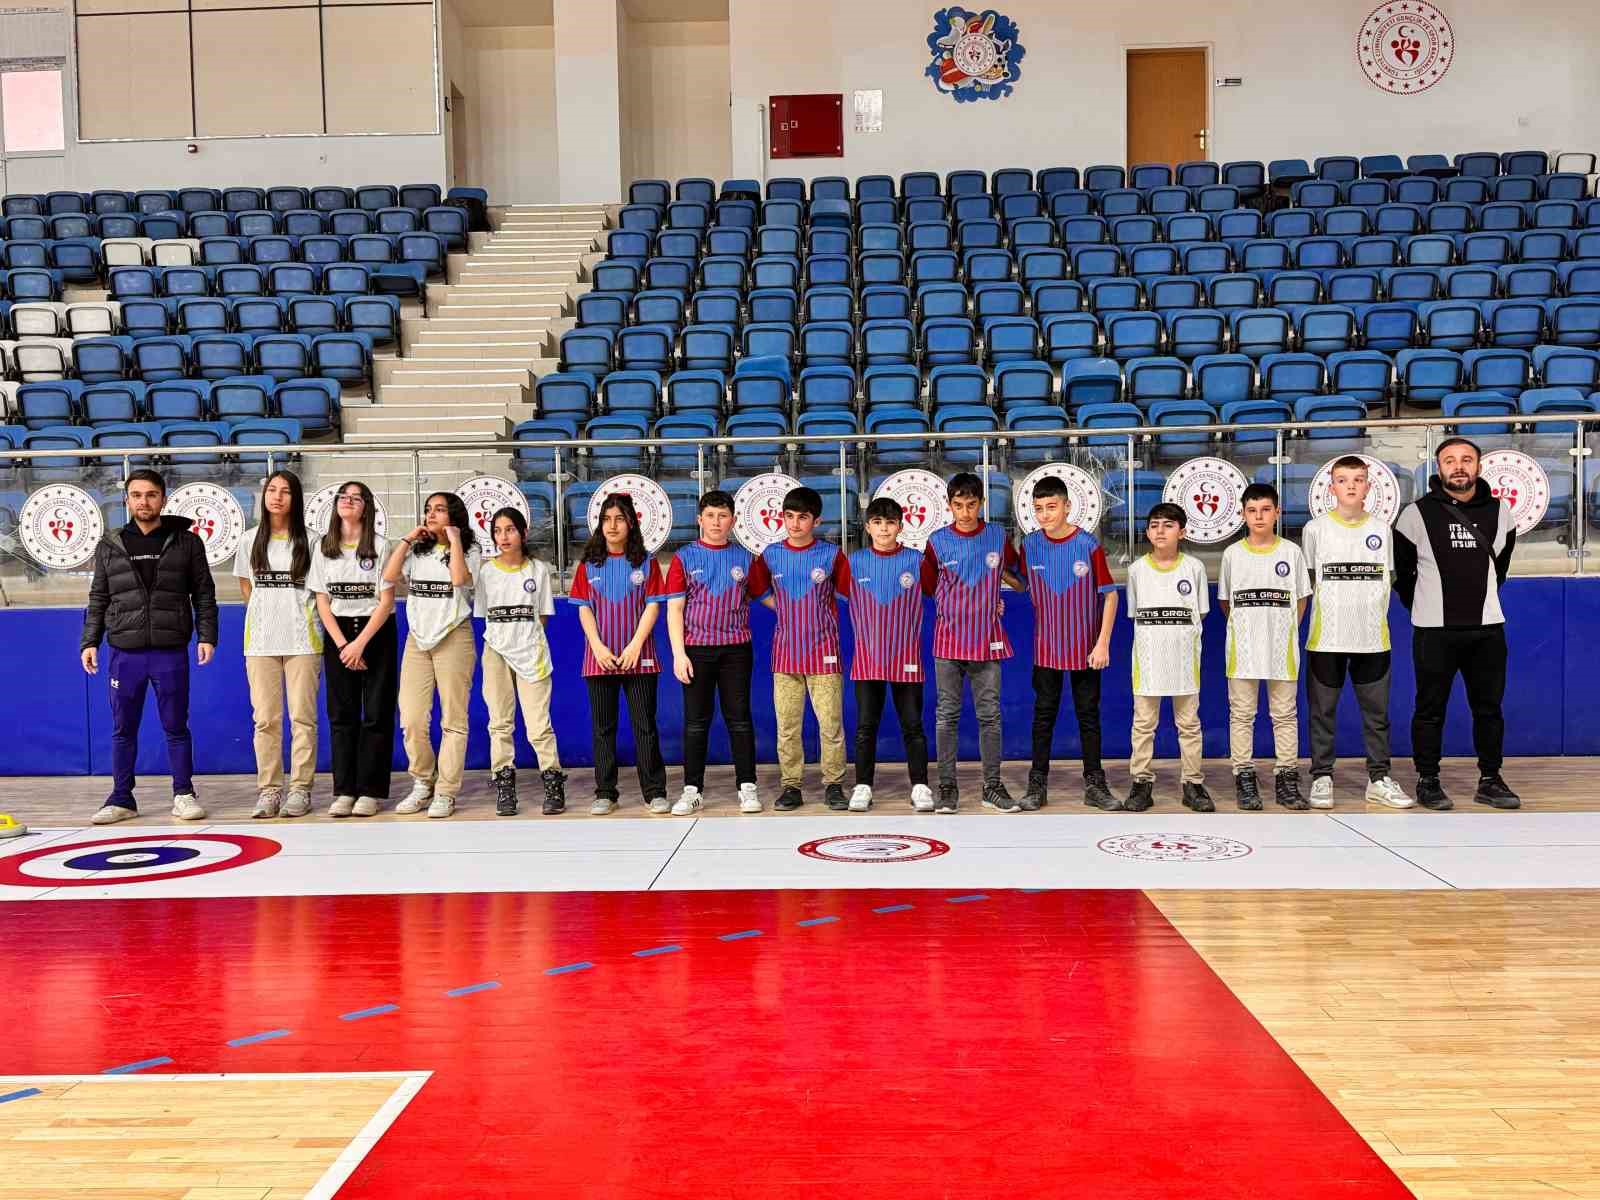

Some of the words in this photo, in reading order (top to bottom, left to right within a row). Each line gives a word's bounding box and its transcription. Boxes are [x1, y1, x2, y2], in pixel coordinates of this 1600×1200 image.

[1451, 531, 1457, 540] A
[1457, 531, 1476, 540] GAM
[1452, 540, 1464, 549] IT'S
[1465, 540, 1477, 549] LIFE
